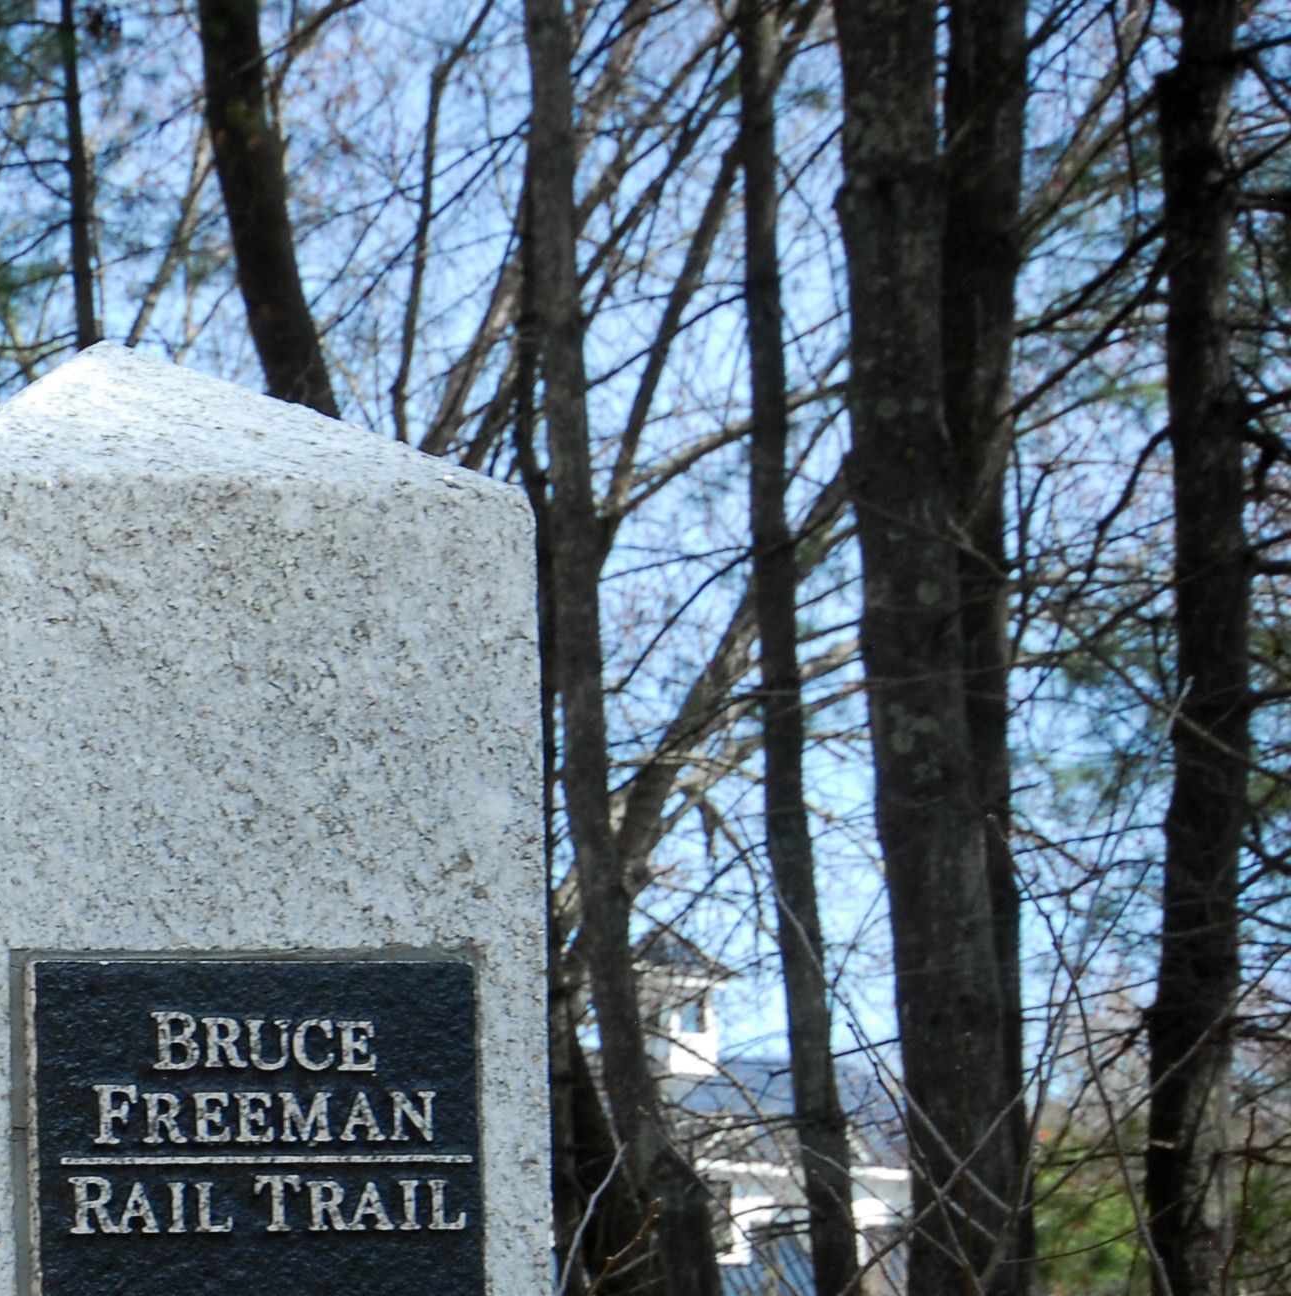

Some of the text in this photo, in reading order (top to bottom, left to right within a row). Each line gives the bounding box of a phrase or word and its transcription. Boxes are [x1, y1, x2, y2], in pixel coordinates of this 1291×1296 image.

[151, 1010, 377, 1072] BRUCE
[93, 1083, 438, 1145] FREEMAN
[68, 1173, 468, 1235] RAIL TRAIL
